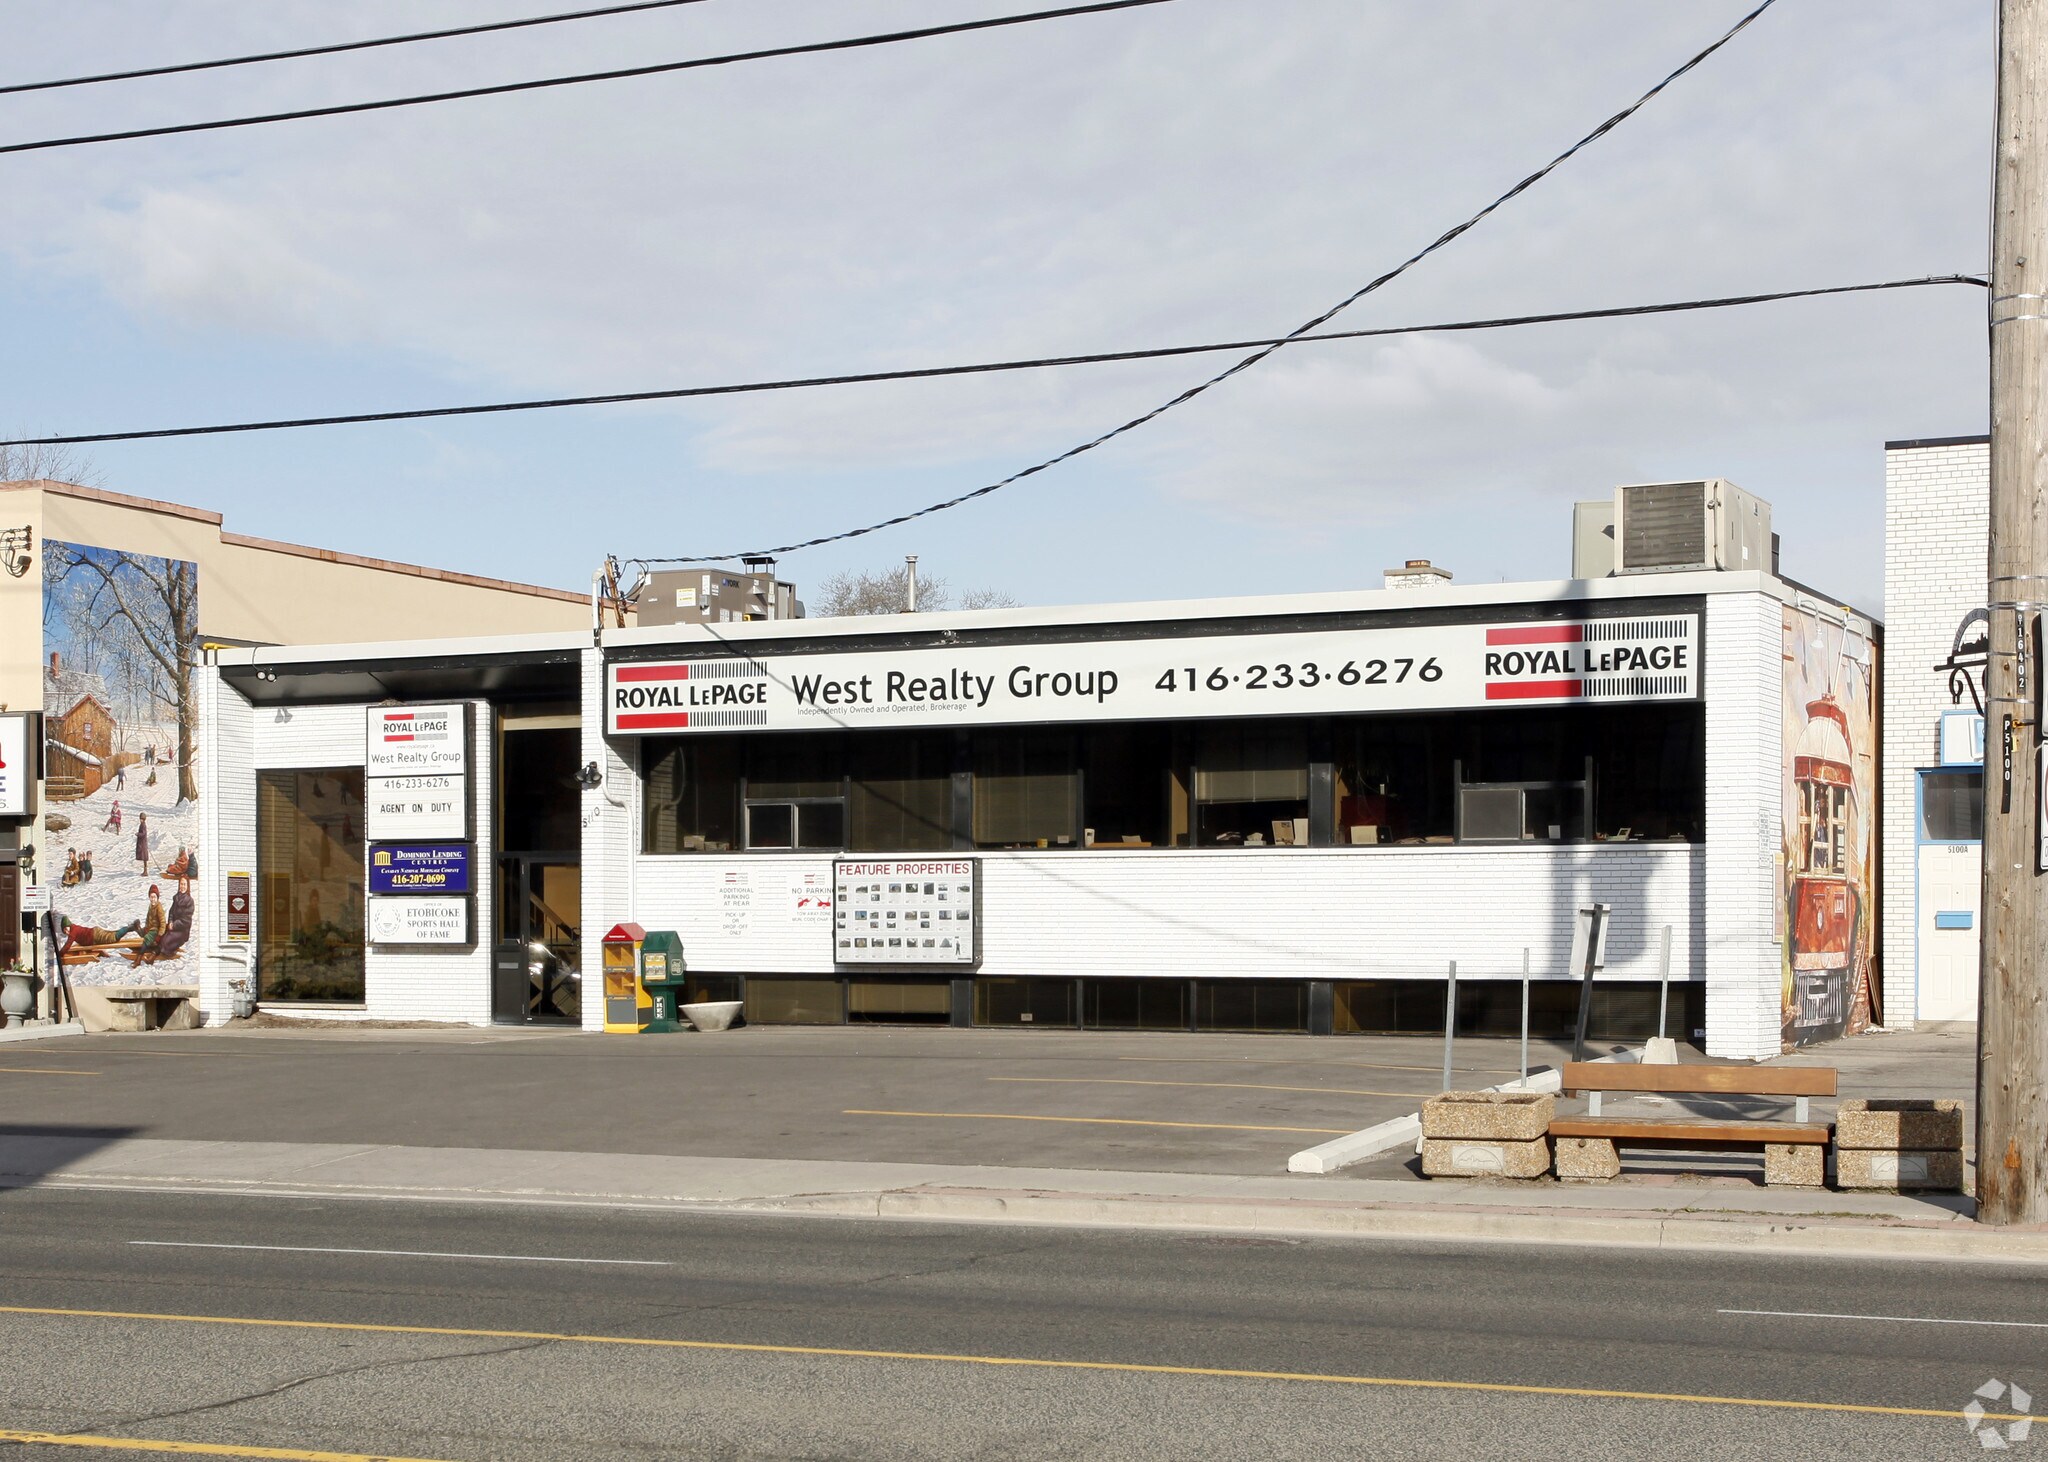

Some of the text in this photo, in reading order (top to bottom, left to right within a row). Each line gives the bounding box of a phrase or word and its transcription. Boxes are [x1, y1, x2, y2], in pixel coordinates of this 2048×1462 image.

[1485, 650, 1575, 676] ROYAL
[791, 665, 1118, 707] West Realty Group
[616, 686, 683, 708] ROYAL
[797, 702, 967, 716] Independently Owned and Operated, Brokerage
[383, 723, 412, 732] ROYAL
[371, 751, 461, 764] West Realty Group
[384, 778, 450, 789] 416-233-6276
[380, 803, 452, 813] AGENT ON DUTY
[396, 850, 462, 858] DOMINION LENDING
[839, 863, 970, 875] FEATURE PROPERTIES
[391, 874, 446, 884] 416-207-0699
[407, 908, 460, 917] ETOBICOKE
[408, 920, 438, 928] SPORTS
